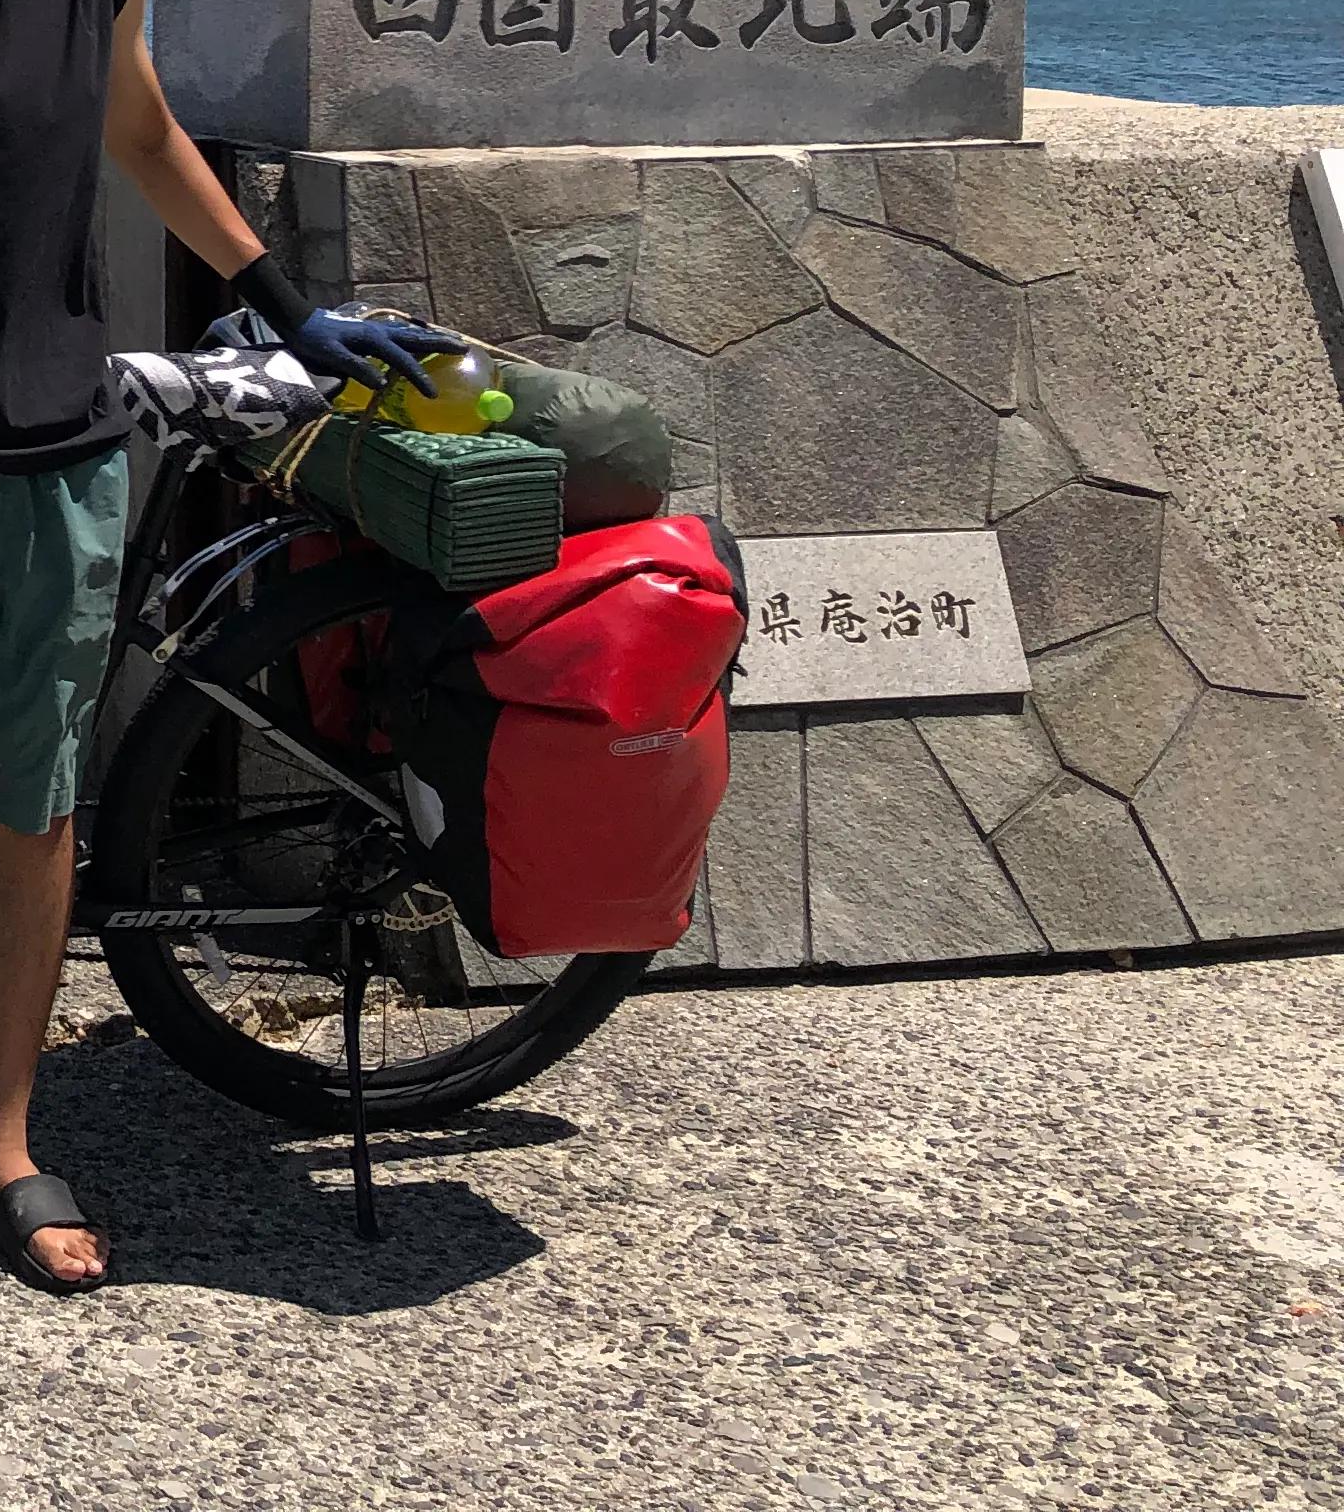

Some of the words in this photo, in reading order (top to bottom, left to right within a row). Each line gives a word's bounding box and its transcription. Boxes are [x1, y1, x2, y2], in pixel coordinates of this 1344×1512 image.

[744, 588, 976, 645] 県庵治町
[104, 908, 246, 928] GIANT
